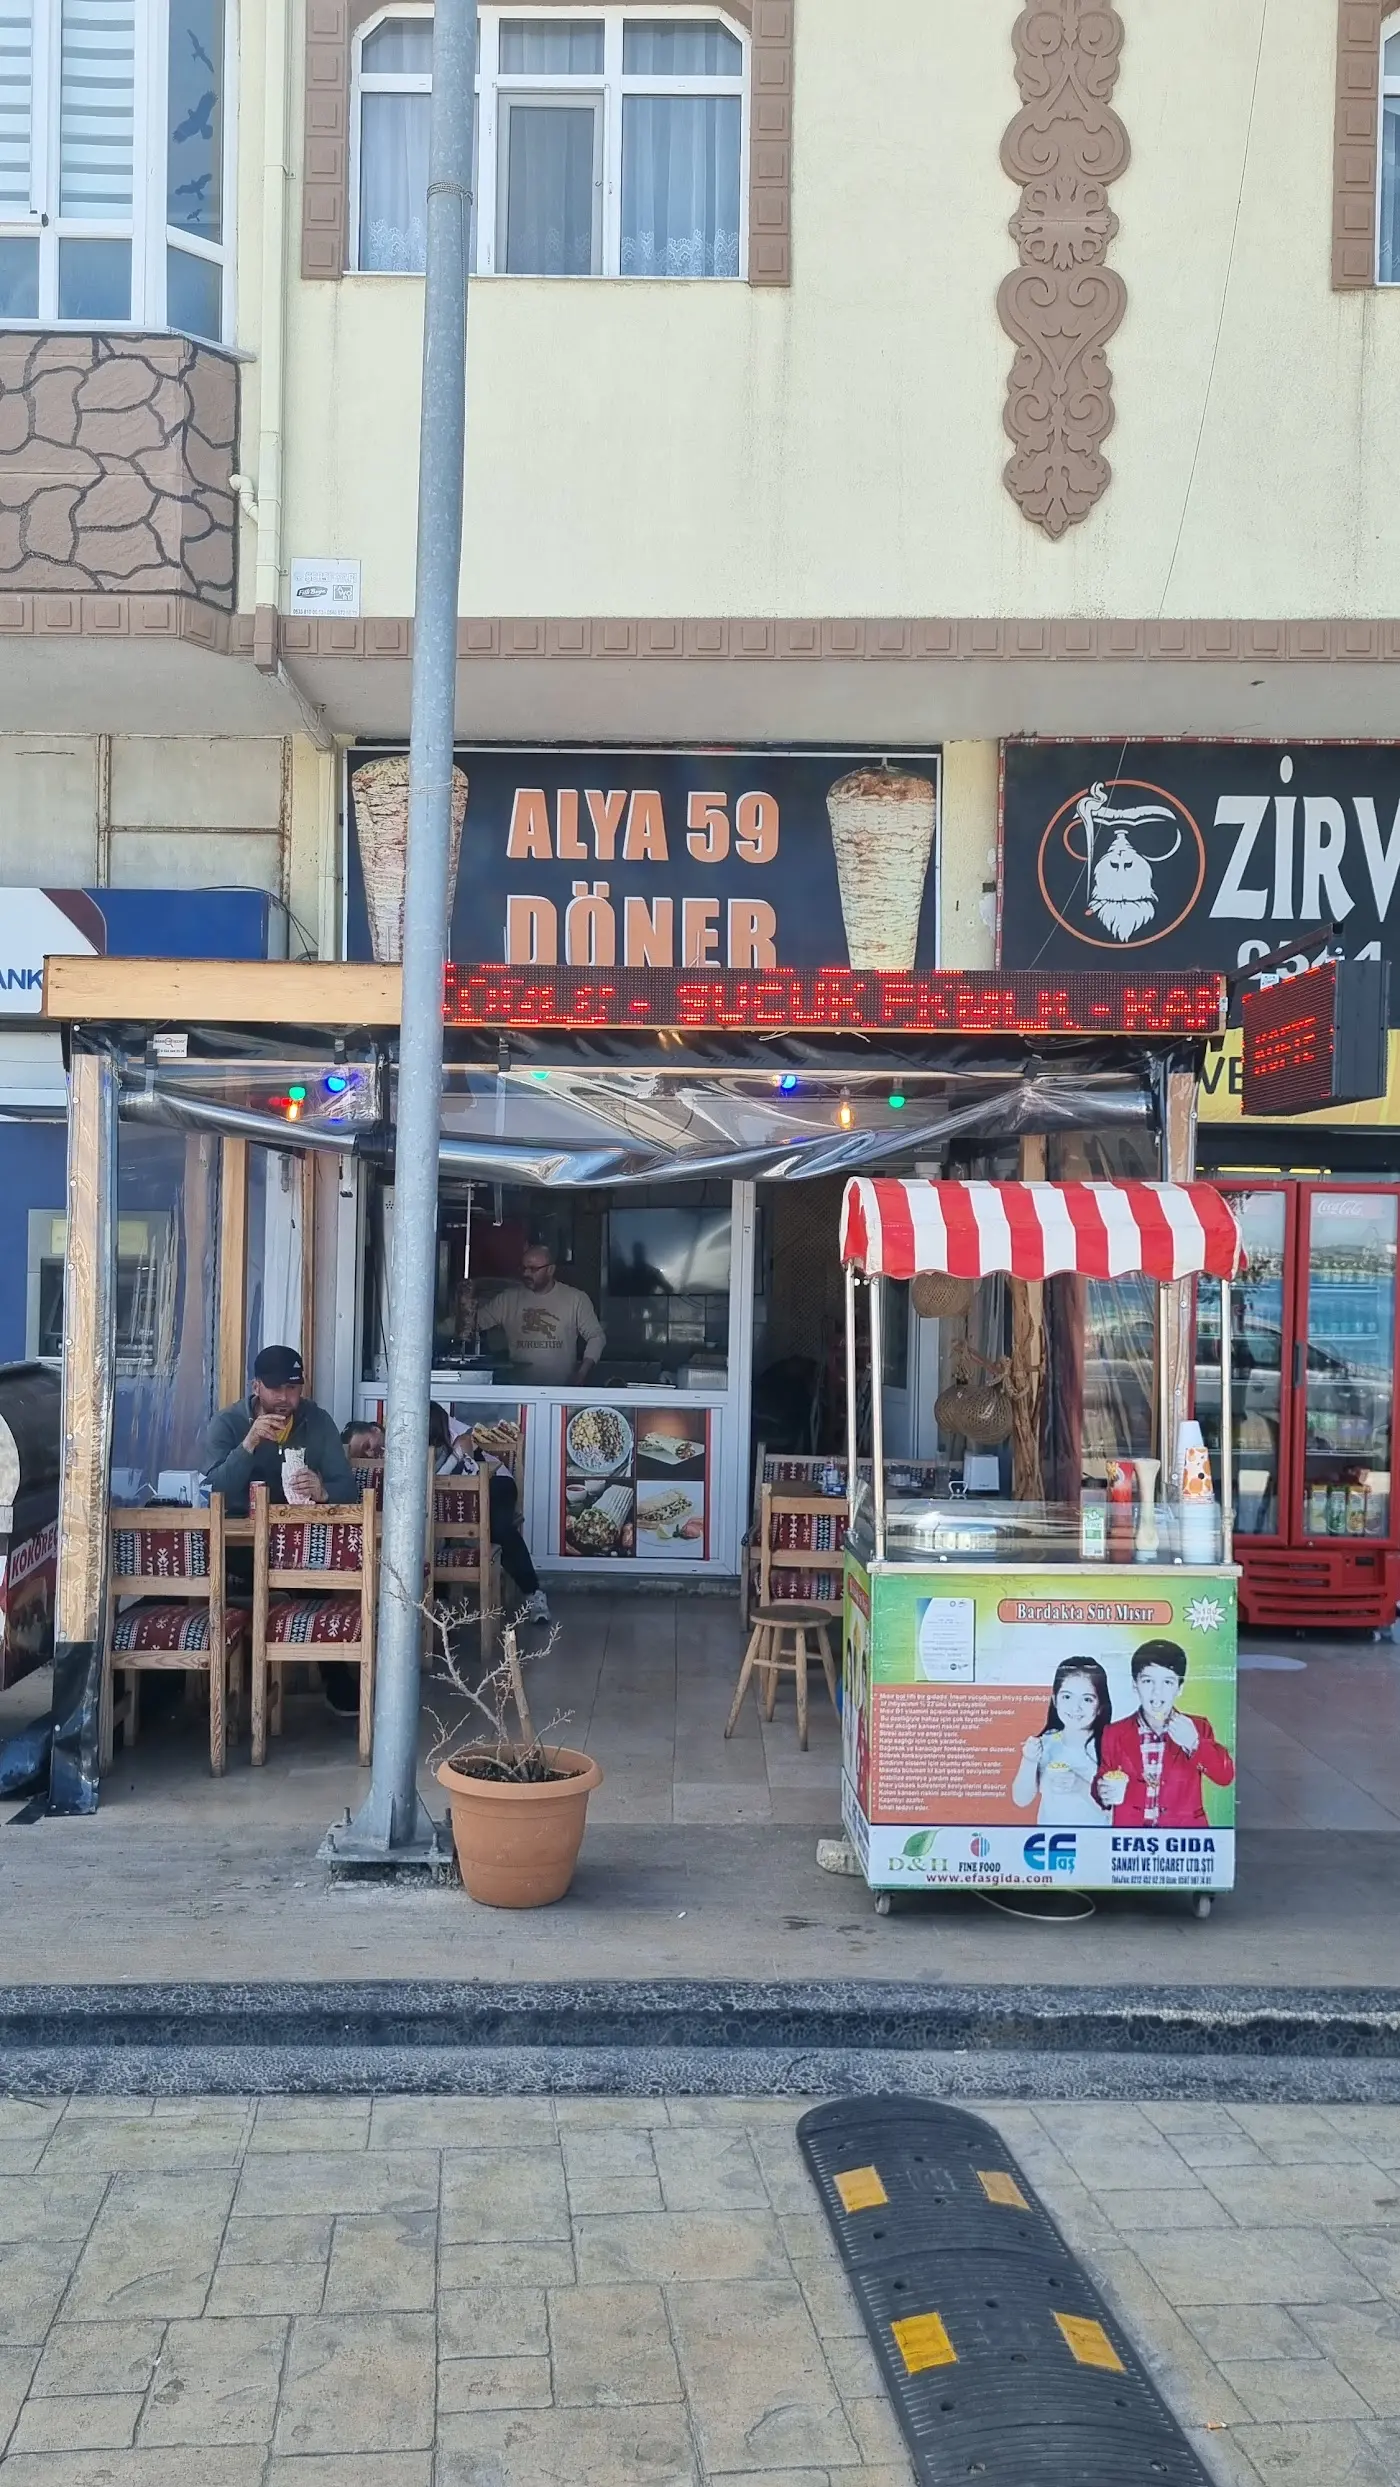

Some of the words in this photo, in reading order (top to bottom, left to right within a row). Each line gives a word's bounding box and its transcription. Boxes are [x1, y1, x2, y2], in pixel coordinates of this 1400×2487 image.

[506, 788, 669, 862] ALYA
[686, 790, 780, 864] 59
[506, 881, 778, 968] DÖNER
[1016, 1603, 1083, 1620] Bardakta
[1087, 1603, 1111, 1620] Süt
[1114, 1604, 1154, 1621] Mısır
[1111, 1837, 1159, 1855] EFAŞ
[1165, 1837, 1215, 1852] GIDA
[958, 1862, 977, 1872] FINE
[979, 1862, 1001, 1873] FOOD
[1111, 1855, 1139, 1872] SANAYİ
[1141, 1857, 1151, 1872] VE
[1153, 1855, 1185, 1872] TİCARET
[926, 1873, 1053, 1885] www.efasgida.com
